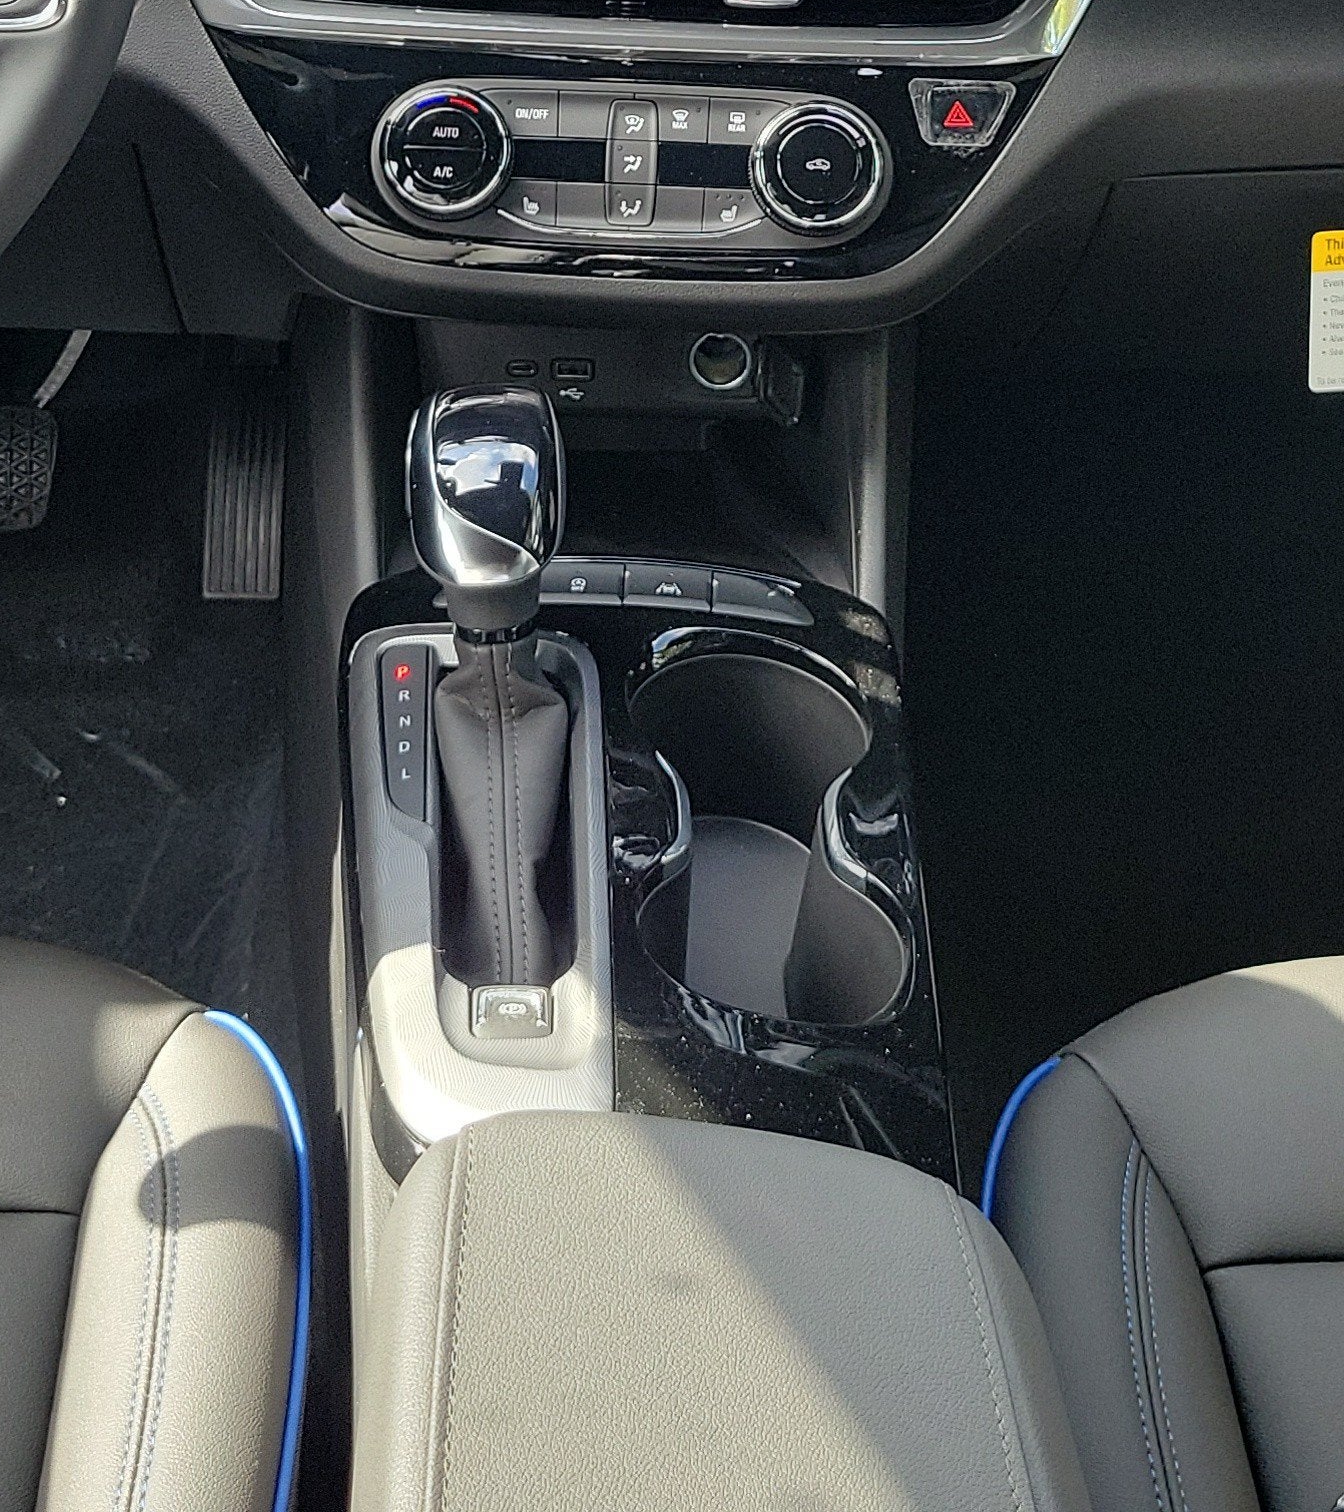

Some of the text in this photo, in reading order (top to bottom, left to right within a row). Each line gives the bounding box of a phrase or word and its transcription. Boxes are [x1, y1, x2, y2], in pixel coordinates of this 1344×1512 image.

[515, 108, 549, 120] ON/OFF
[432, 126, 459, 138] AUTO
[433, 166, 453, 178] A/C
[1323, 278, 1344, 288] Even
[397, 665, 410, 679] P
[398, 690, 410, 702] R
[399, 715, 411, 727] N
[398, 741, 411, 753] D
[401, 768, 411, 779] L
